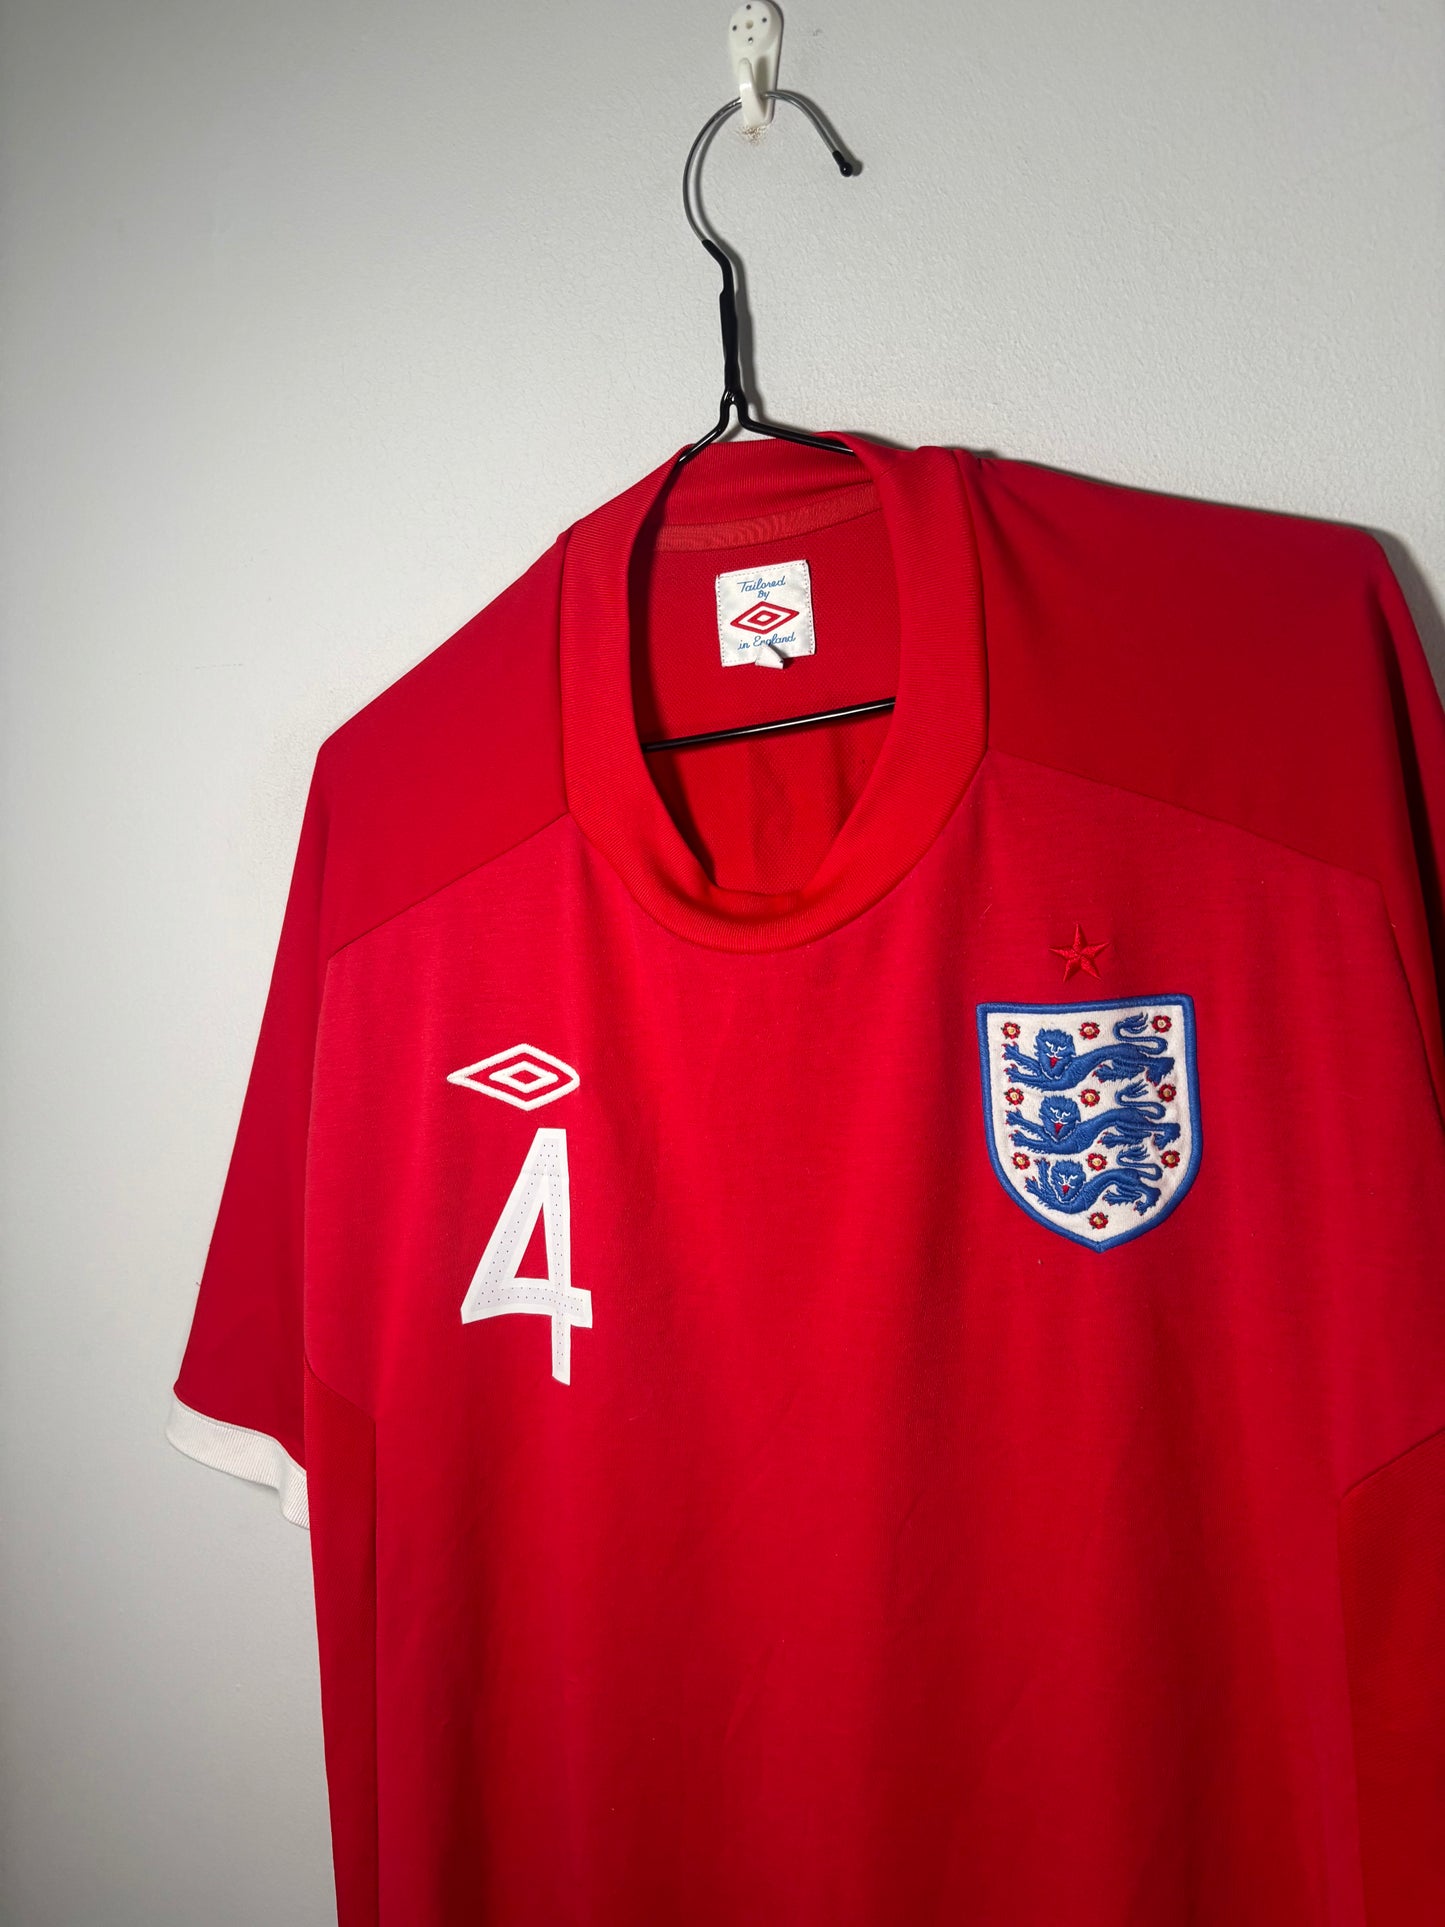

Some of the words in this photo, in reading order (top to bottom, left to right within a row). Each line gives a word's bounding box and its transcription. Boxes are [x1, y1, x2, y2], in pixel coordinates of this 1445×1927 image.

[737, 576, 786, 592] Tailored
[737, 640, 750, 651] in
[460, 1127, 592, 1386] 4
